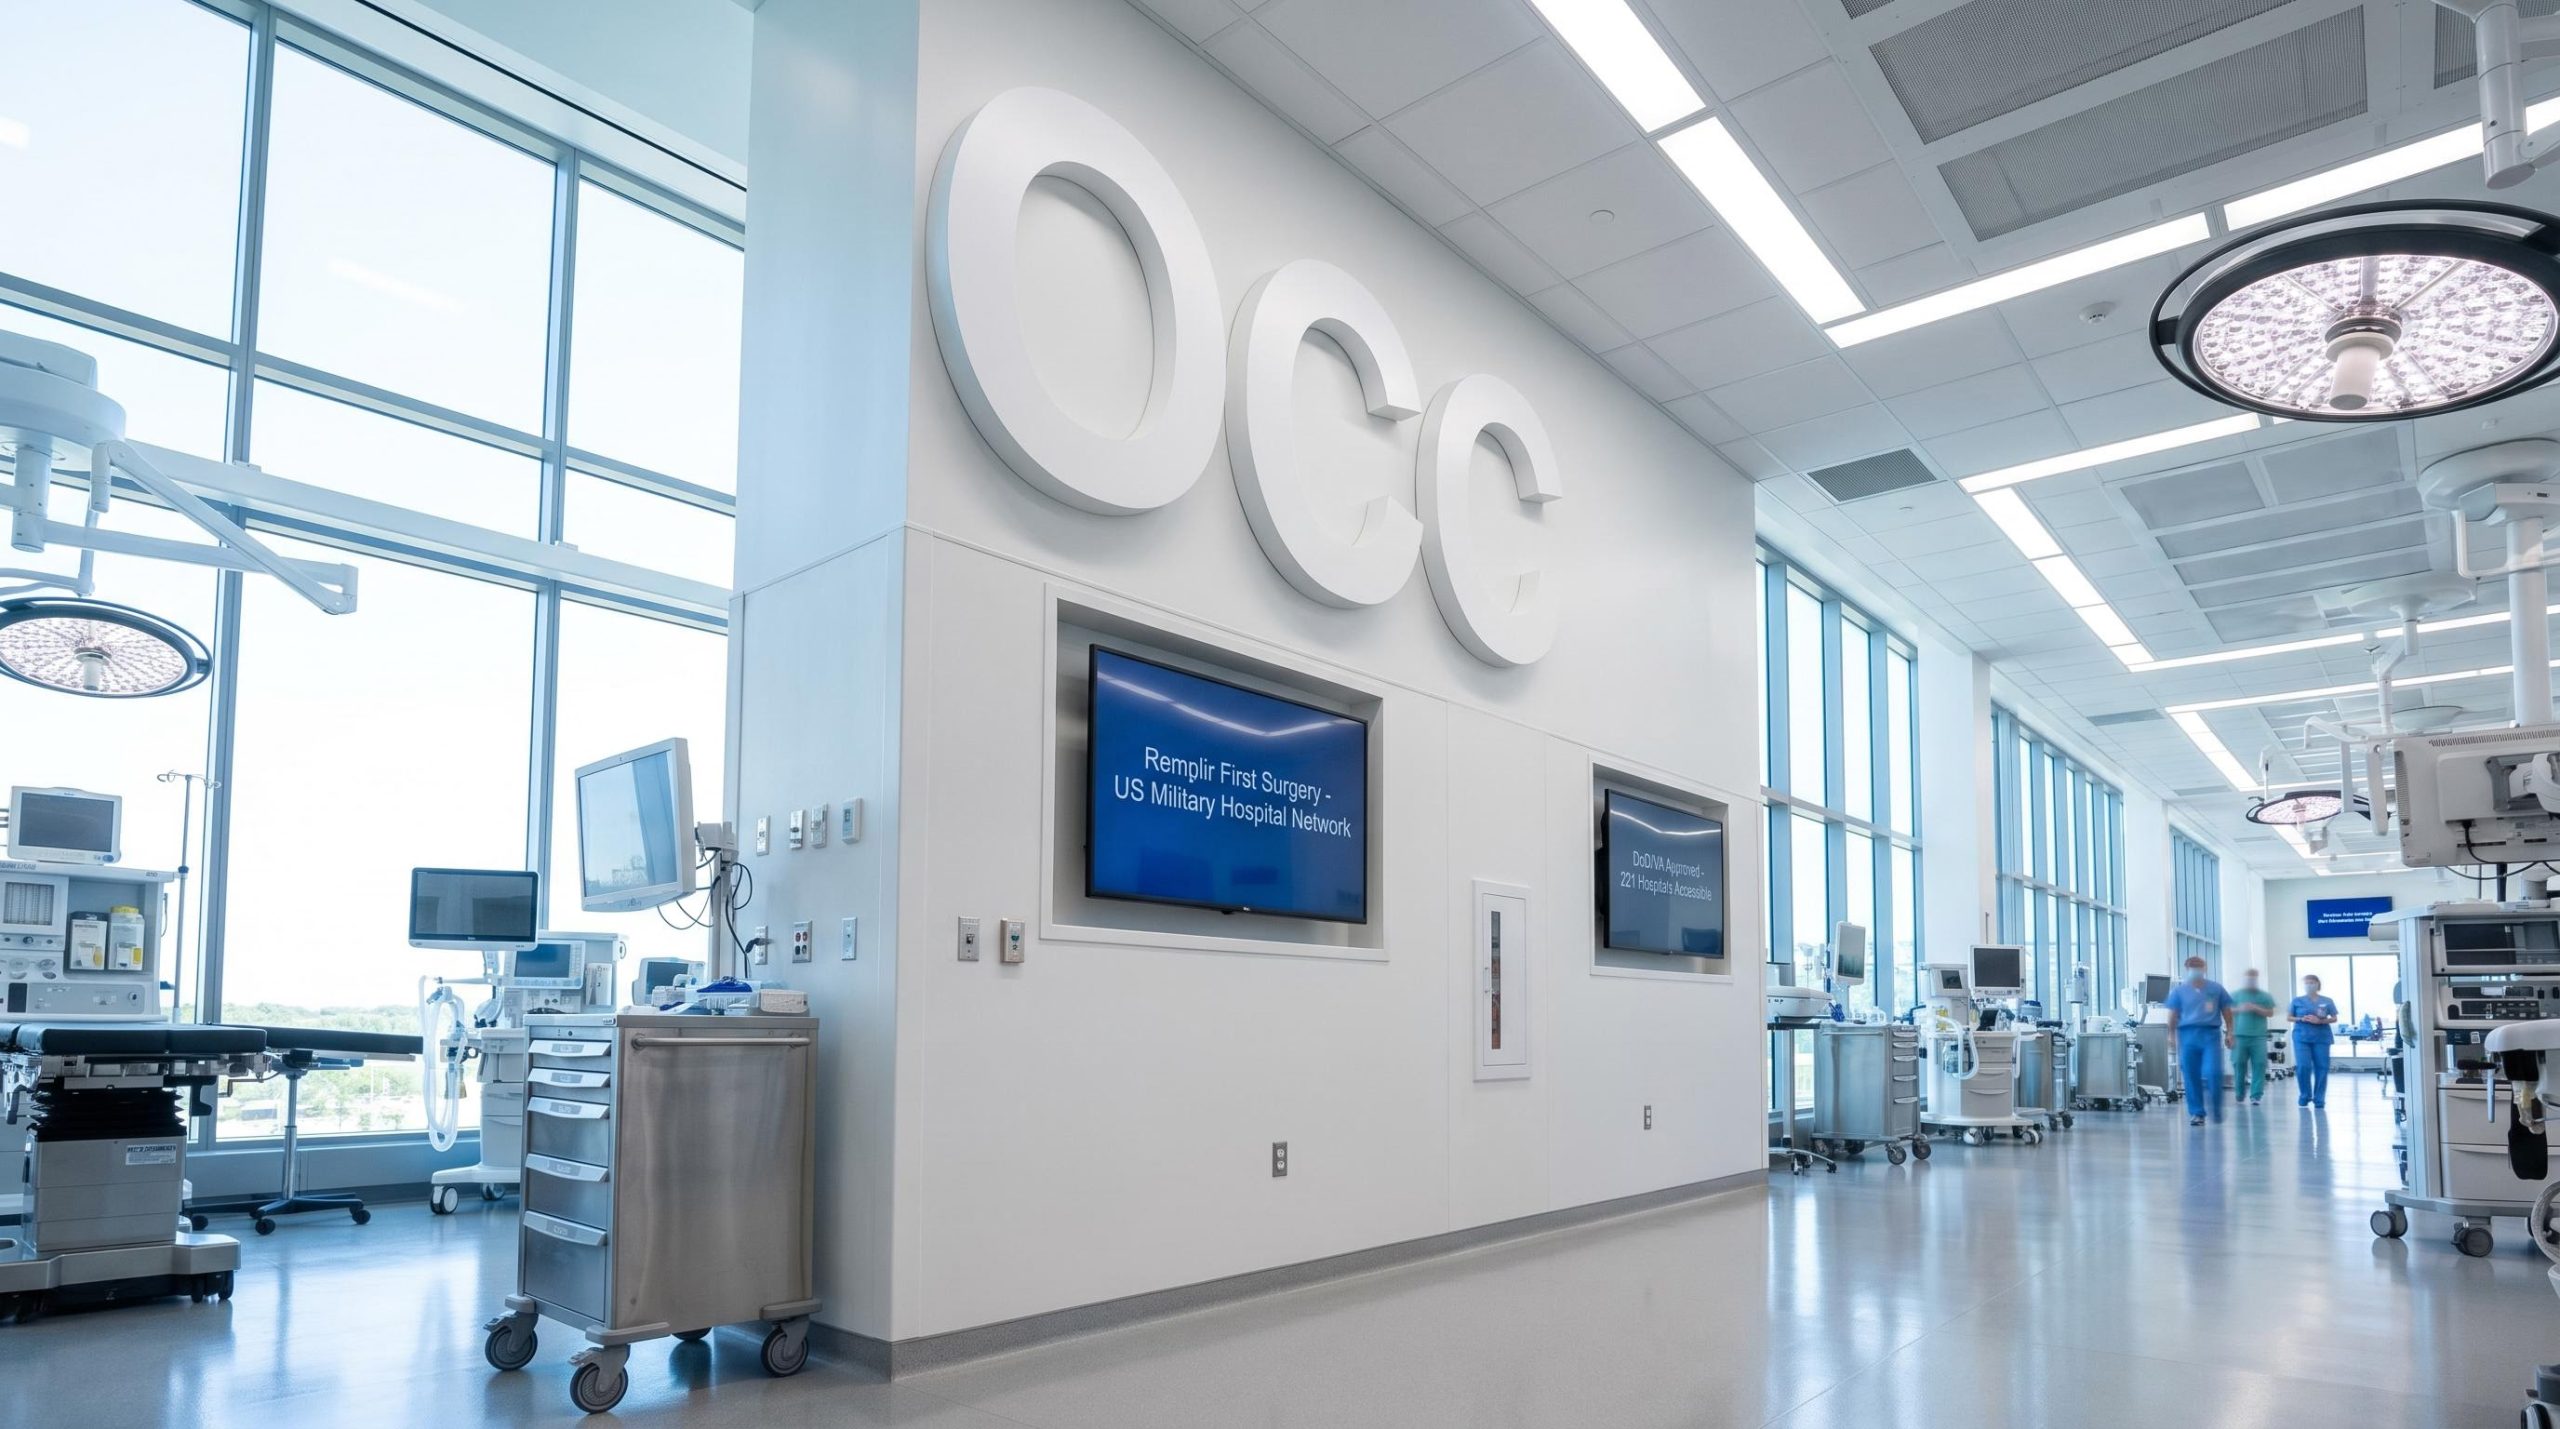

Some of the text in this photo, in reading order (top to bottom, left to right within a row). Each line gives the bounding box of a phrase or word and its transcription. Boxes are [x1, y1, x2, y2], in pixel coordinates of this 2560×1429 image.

[925, 85, 1563, 668] OCC
[1145, 746, 1215, 783] Remplir
[1220, 762, 1257, 790] First
[1261, 771, 1322, 806] Surgery
[1114, 775, 1352, 838] US Military Hospital Network
[1620, 871, 1712, 901] 221 Hospitals Accessible
[1632, 850, 1665, 872] DoD/VA
[1665, 857, 1700, 879] Approved
